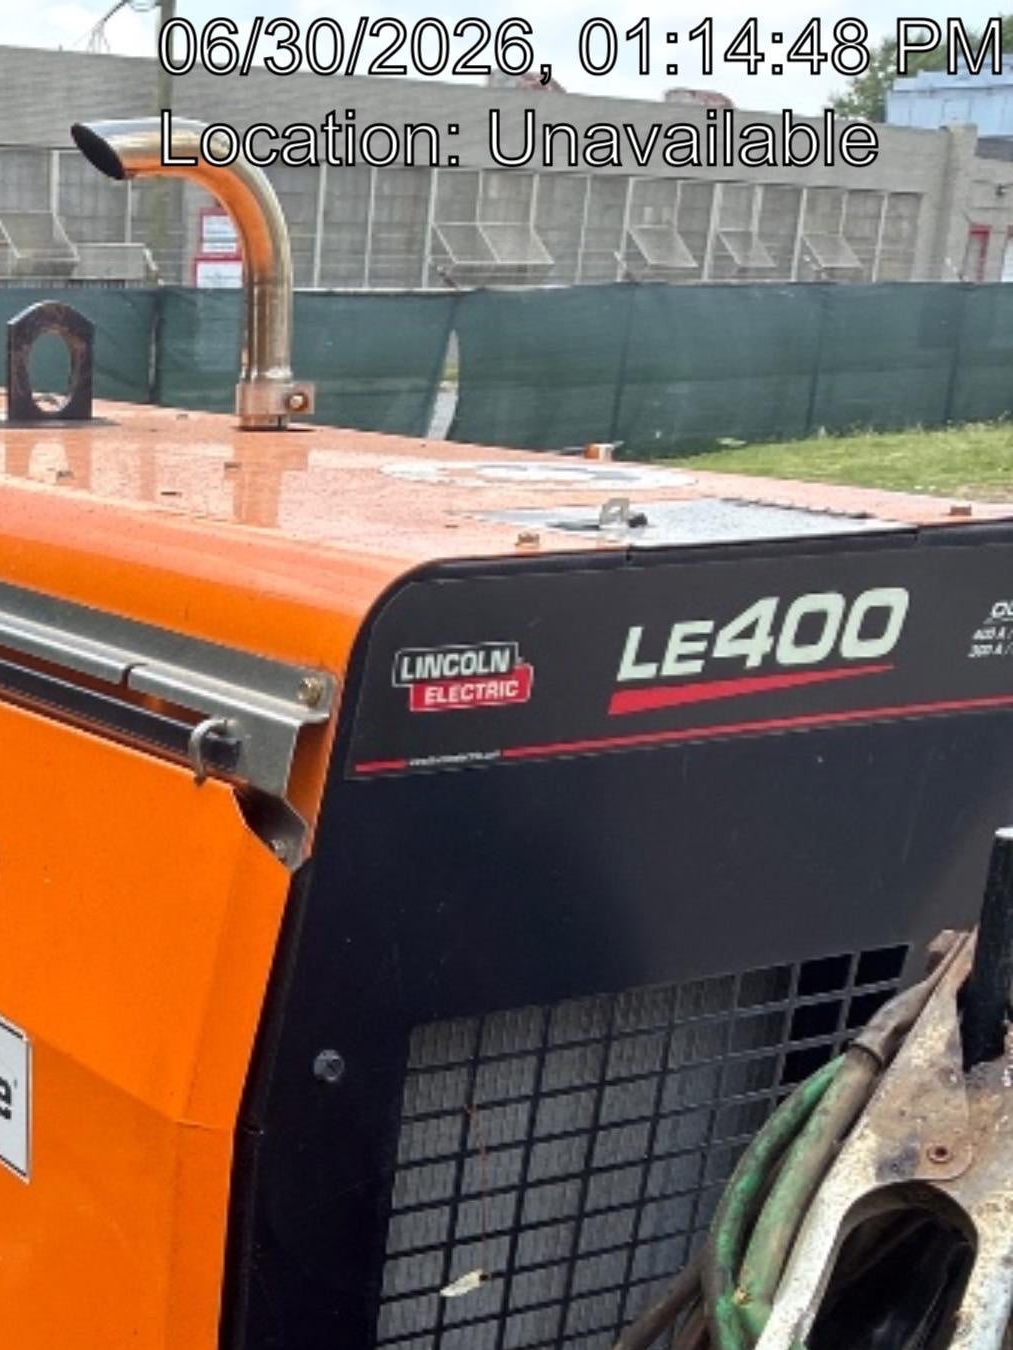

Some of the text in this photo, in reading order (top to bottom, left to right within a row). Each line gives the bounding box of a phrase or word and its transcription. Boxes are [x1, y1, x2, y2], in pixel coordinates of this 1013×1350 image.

[617, 587, 909, 682] LE400
[401, 649, 511, 681] LINCOLN
[424, 679, 520, 705] ELECTRIC
